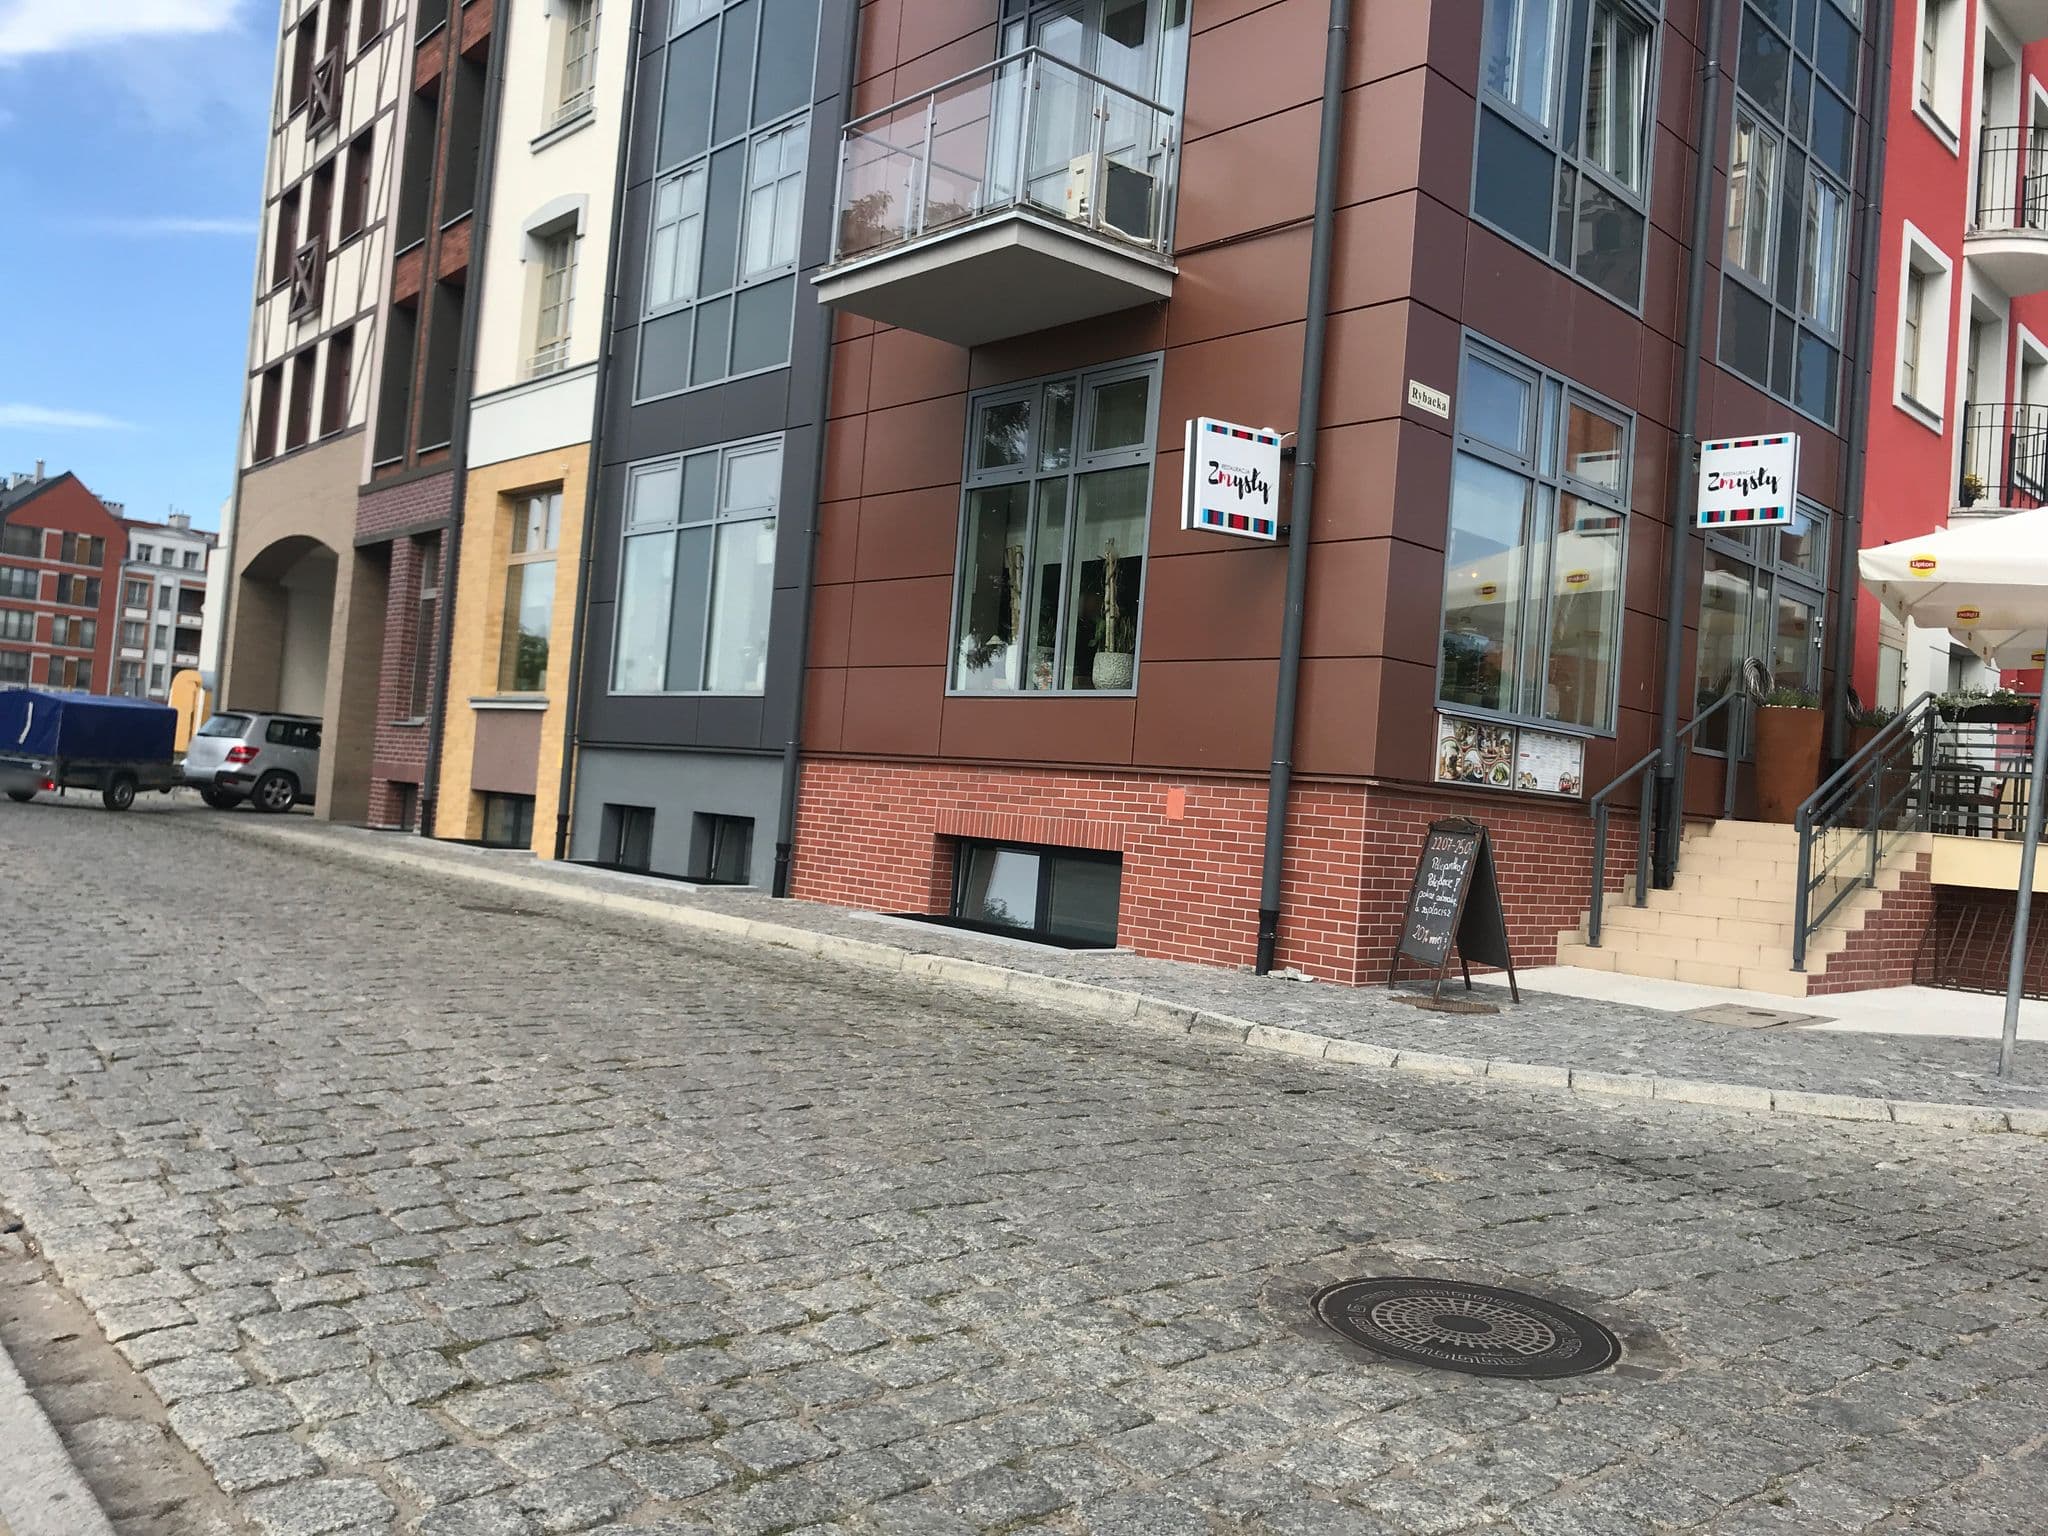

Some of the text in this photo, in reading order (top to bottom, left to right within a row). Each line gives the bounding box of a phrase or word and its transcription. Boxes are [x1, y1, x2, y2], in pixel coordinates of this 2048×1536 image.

[1412, 386, 1447, 412] Rybacka
[1208, 460, 1272, 504] Zmysły
[1707, 466, 1782, 497] Zmysły
[1911, 560, 1935, 569] Lipton
